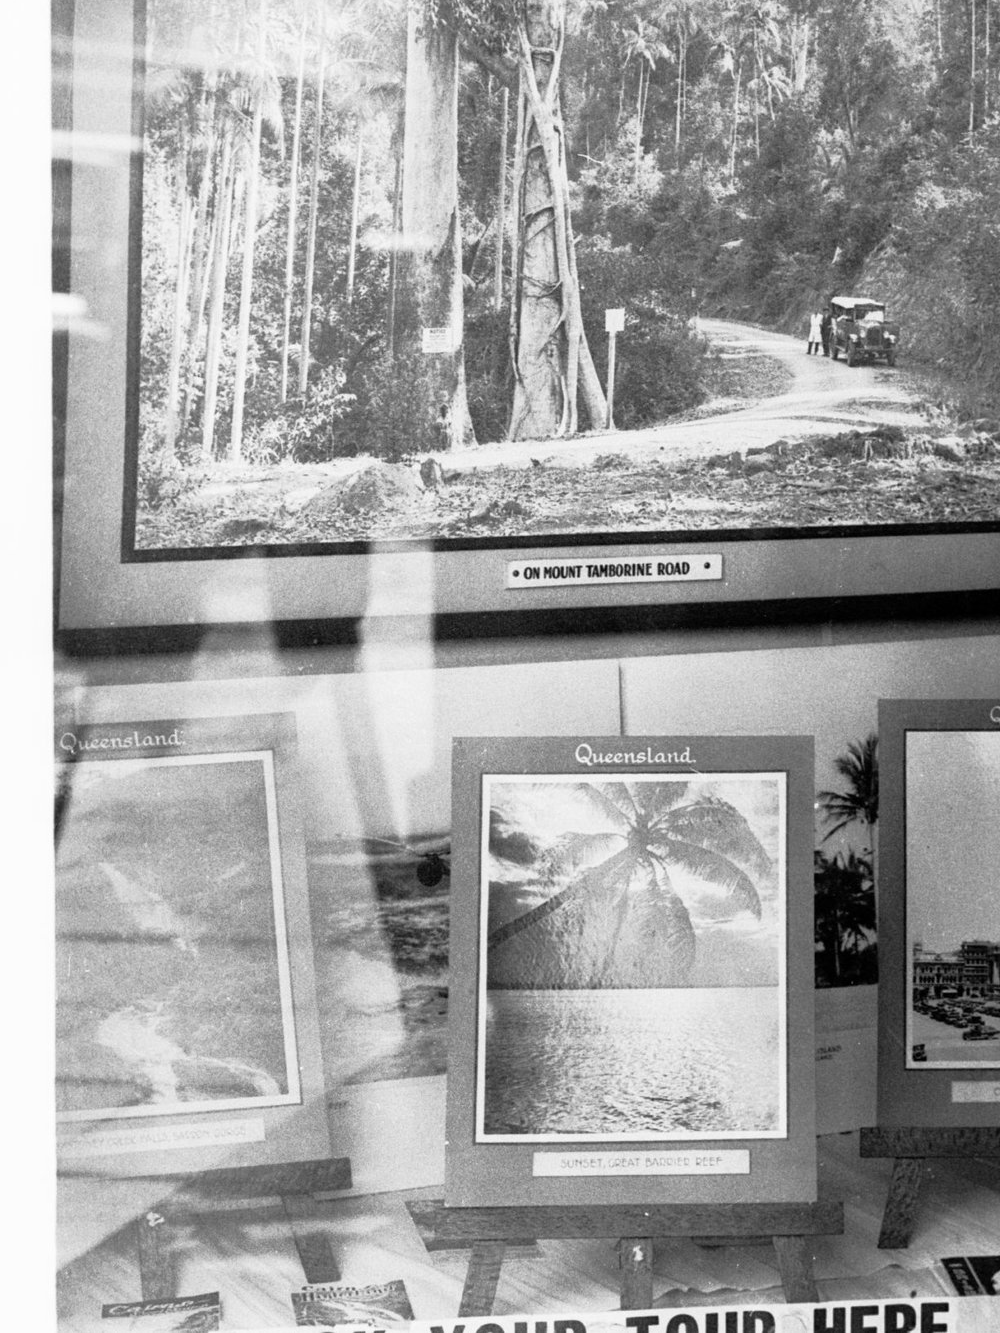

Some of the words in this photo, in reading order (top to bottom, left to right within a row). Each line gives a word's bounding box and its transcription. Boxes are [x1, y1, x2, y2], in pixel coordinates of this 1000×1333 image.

[523, 567, 541, 580] ON
[543, 565, 582, 579] MOUNT
[585, 563, 652, 578] TAMBORINE
[657, 561, 690, 576] ROAD
[608, 1157, 640, 1168] GREAT
[644, 1156, 690, 1168] BARRIER
[695, 1156, 724, 1167] REEF
